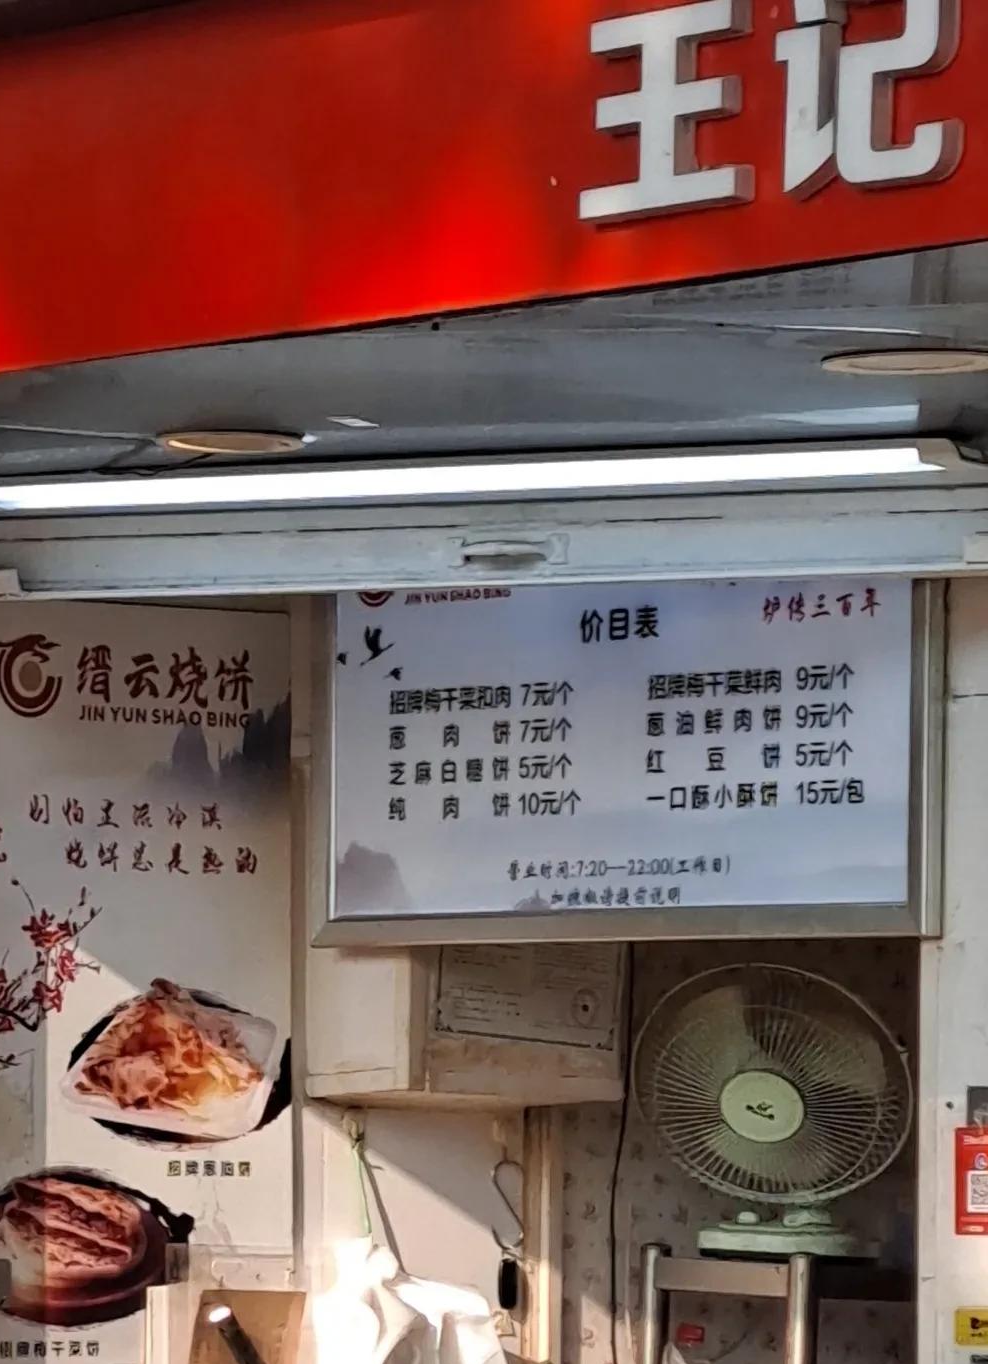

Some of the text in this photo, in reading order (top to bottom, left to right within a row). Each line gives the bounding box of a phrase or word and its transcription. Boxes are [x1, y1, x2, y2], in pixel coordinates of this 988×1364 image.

[579, 0, 965, 225] 王记
[579, 604, 660, 645] 价目表
[76, 644, 255, 710] 缙云烧饼
[795, 662, 856, 691] 9元/个
[519, 681, 575, 707] 7元/个
[78, 704, 252, 729] JIN YUN SHAO BING
[795, 701, 855, 730] 9元/个
[519, 717, 573, 744] 7元/个
[518, 752, 573, 781] 5元/个
[795, 738, 854, 768] 5元/个
[518, 788, 583, 817] 10元/个
[796, 776, 866, 805] 15元/包
